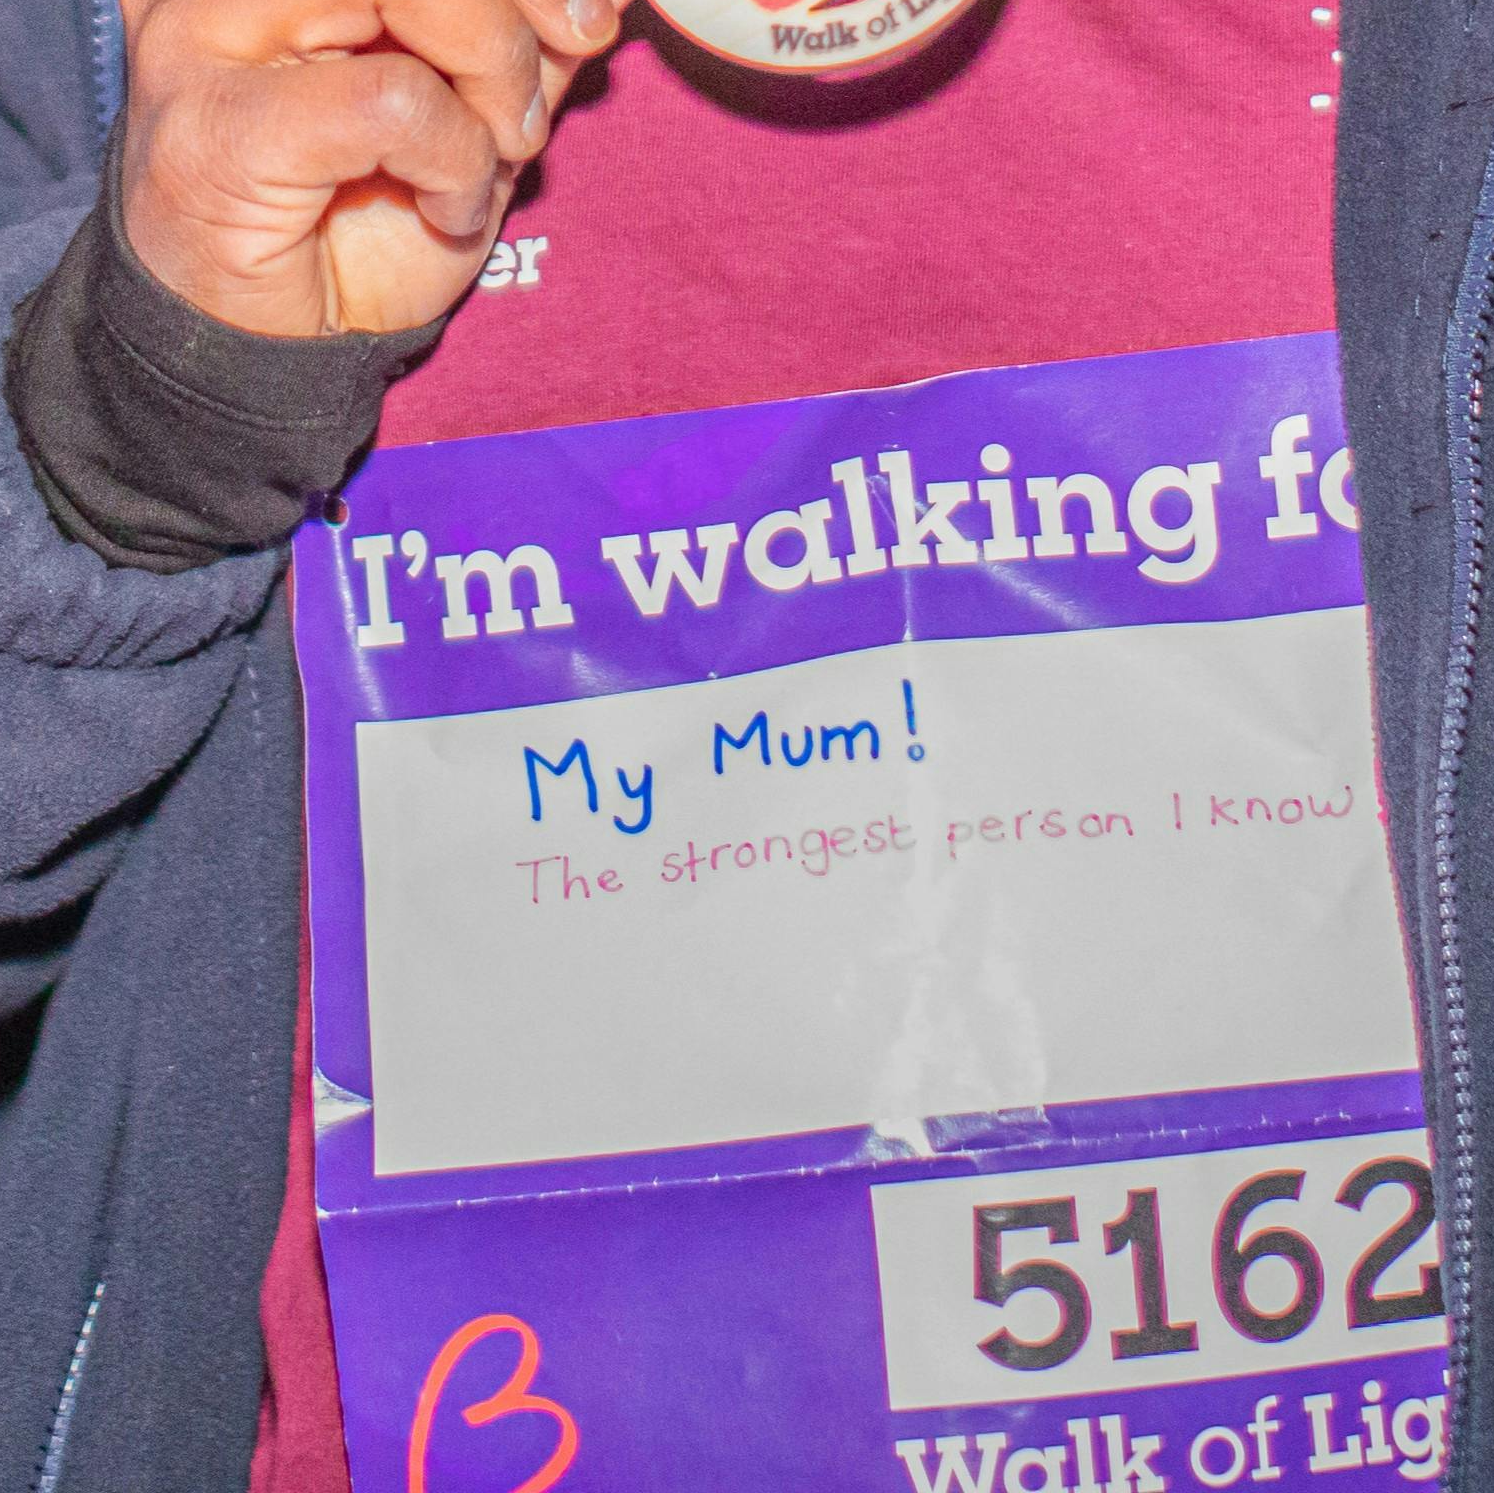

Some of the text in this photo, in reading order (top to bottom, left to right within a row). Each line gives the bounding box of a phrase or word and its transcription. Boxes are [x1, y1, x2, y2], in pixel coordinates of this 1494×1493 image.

[770, 19, 860, 55] Walk
[867, 2, 902, 40] of
[352, 529, 574, 648] I'm
[600, 443, 1221, 618] walking
[523, 679, 926, 835] My Mum!
[516, 784, 1355, 905] The strongest person I know
[972, 1154, 1446, 1372] 5162
[894, 1371, 1453, 1493] Walk of Lig
